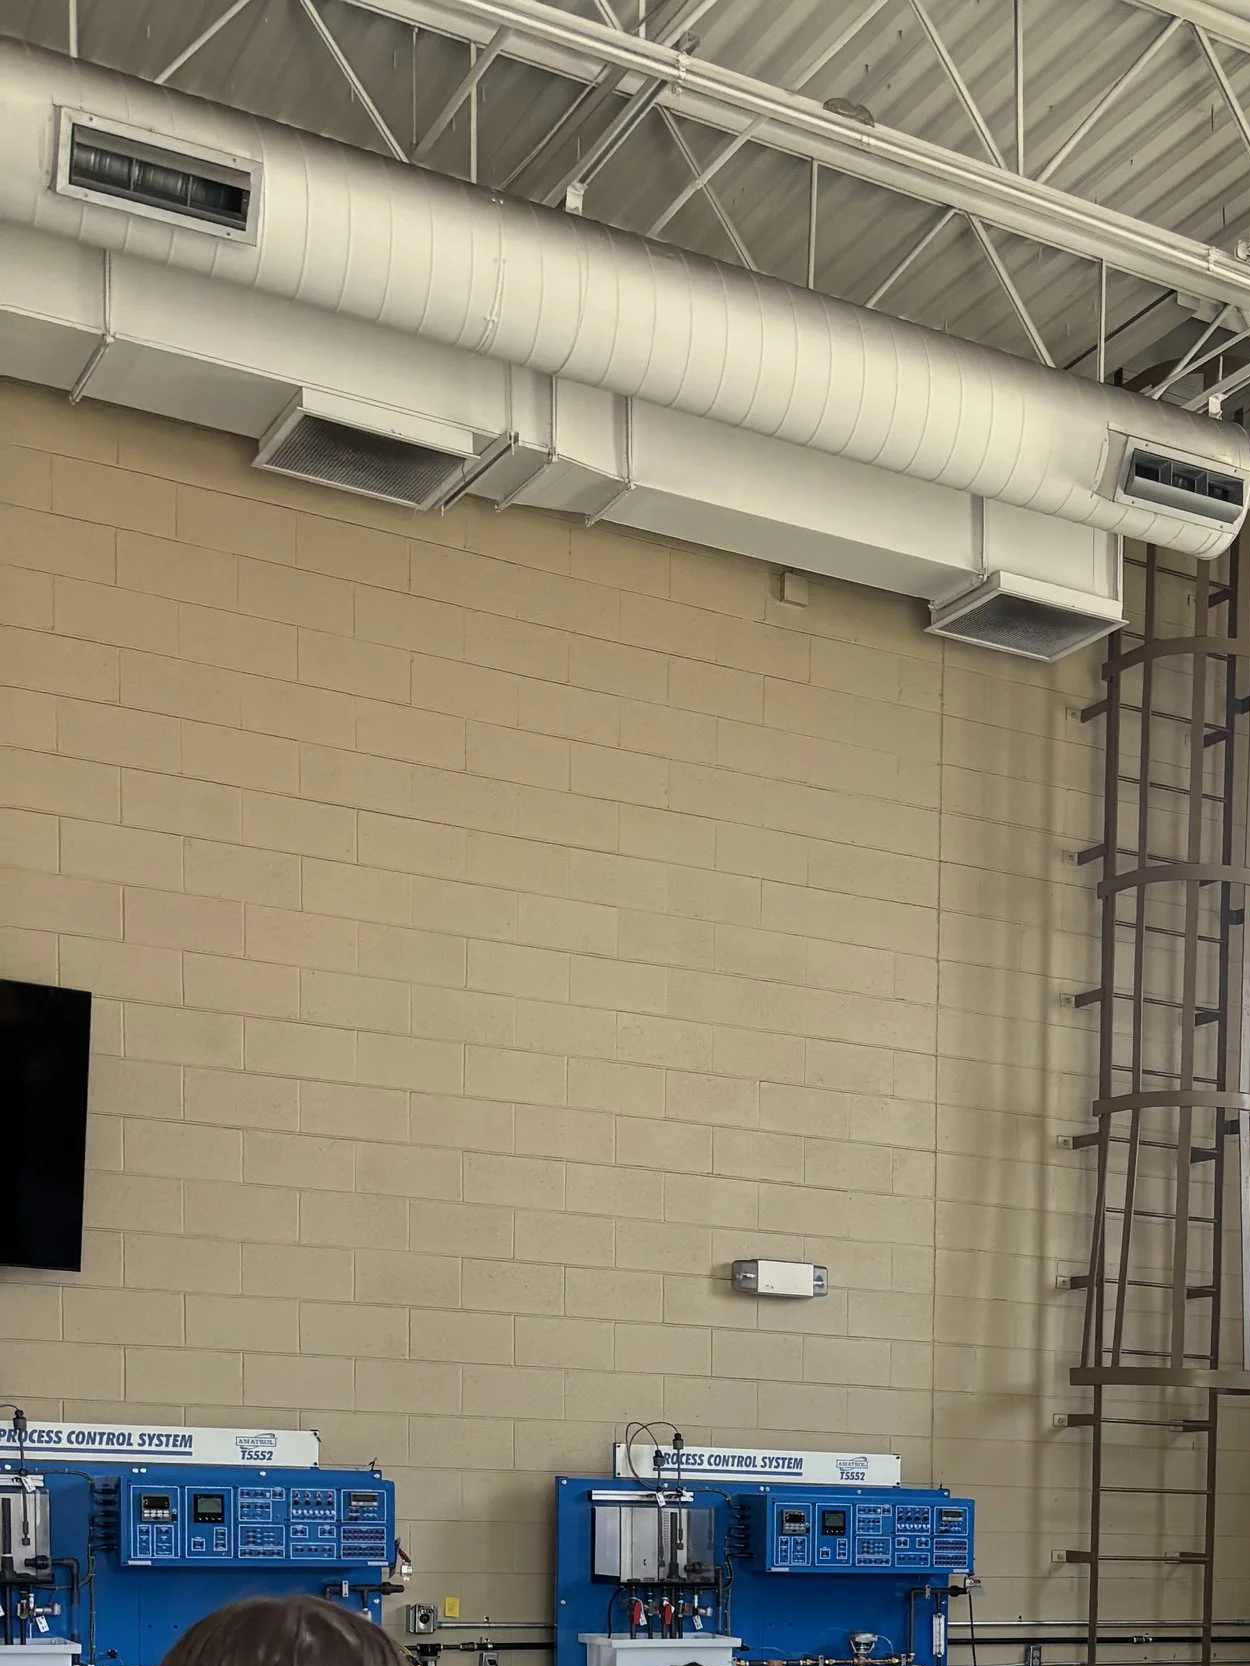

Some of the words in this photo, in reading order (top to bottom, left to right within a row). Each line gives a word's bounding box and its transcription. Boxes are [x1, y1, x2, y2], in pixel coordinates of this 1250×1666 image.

[66, 1431, 133, 1446] CONTROL
[137, 1433, 193, 1448] SYSTEM
[241, 1450, 274, 1461] T5552
[707, 1454, 757, 1468] CONTROL
[761, 1456, 804, 1470] SYSTEM
[840, 1471, 866, 1481] T5552
